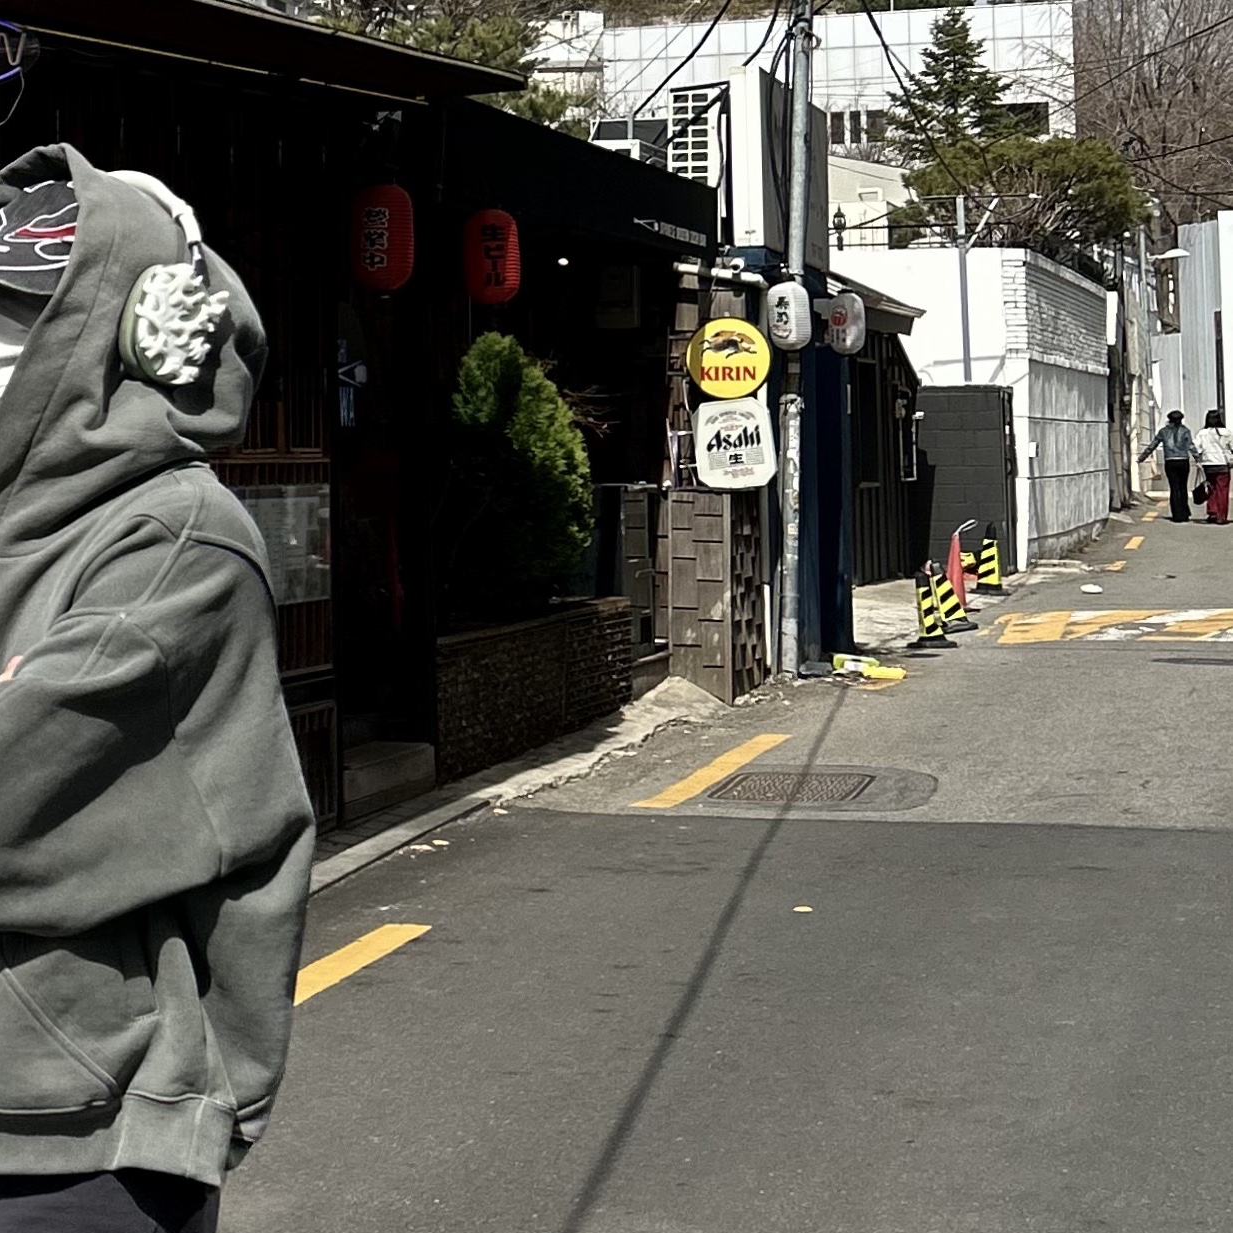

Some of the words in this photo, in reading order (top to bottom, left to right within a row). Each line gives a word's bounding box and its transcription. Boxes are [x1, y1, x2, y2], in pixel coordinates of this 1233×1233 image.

[481, 223, 506, 288] 生ビール
[700, 366, 756, 381] KIRIN
[707, 425, 761, 452] Asahi
[729, 453, 744, 465] 生
